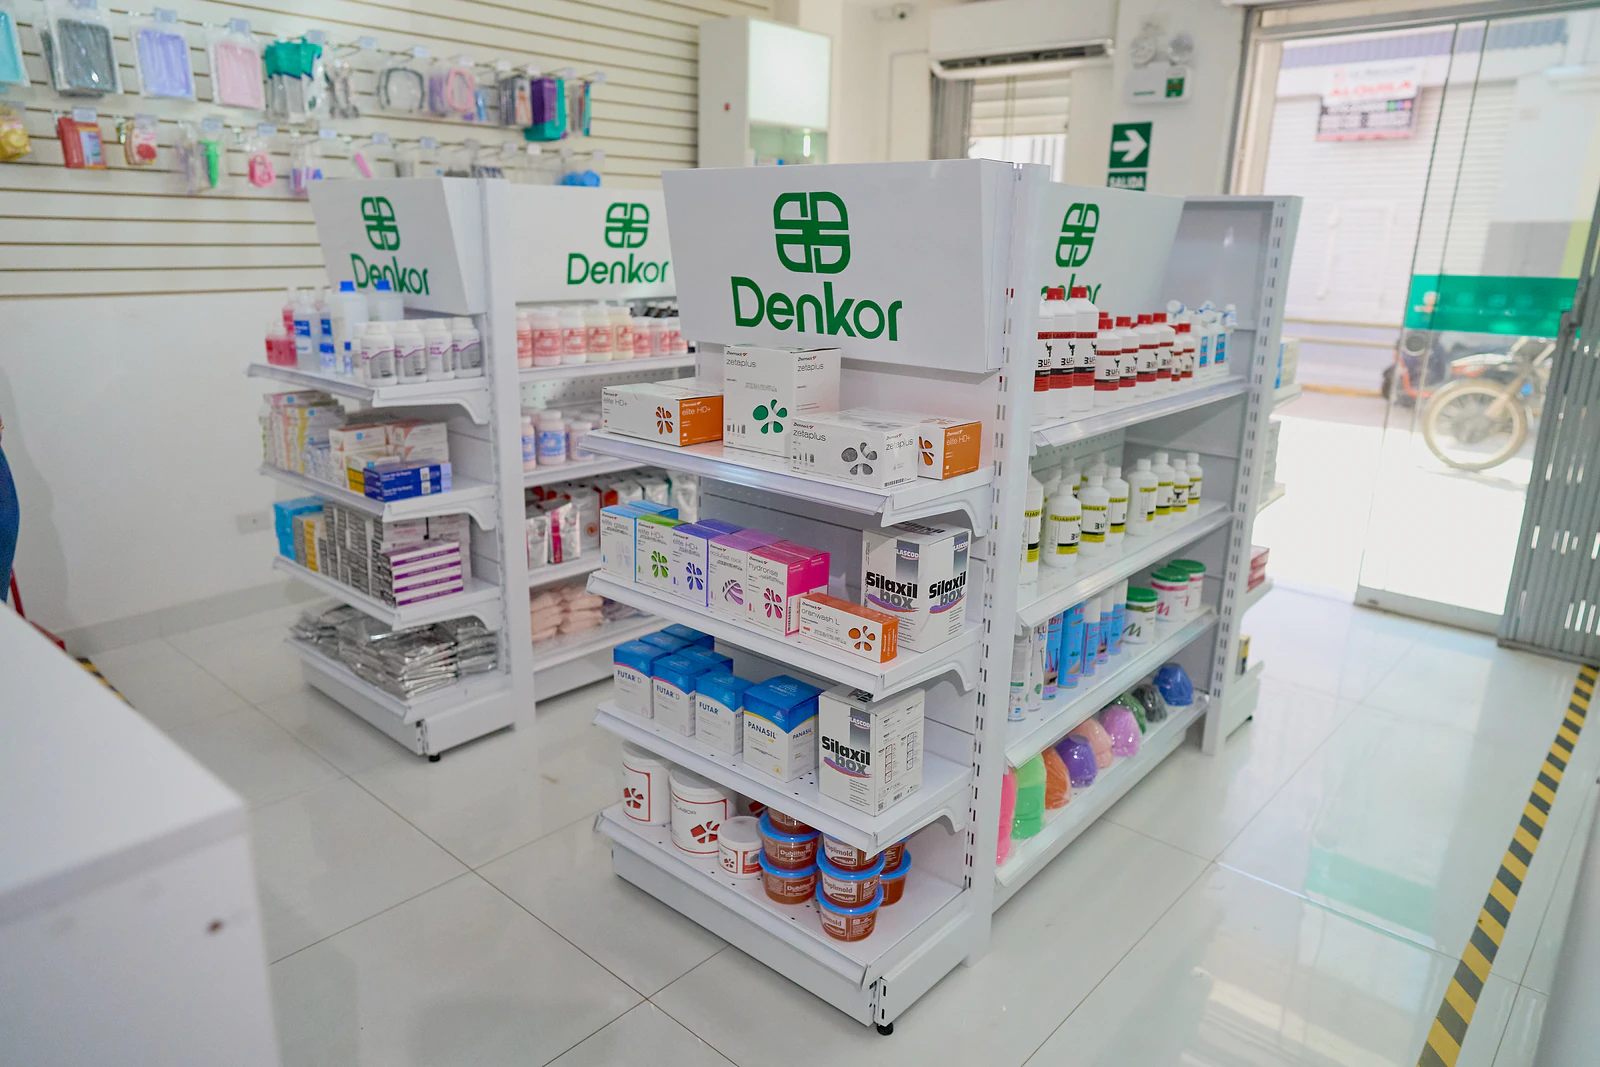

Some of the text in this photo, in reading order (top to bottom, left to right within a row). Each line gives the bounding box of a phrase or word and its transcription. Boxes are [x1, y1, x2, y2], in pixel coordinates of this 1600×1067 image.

[350, 253, 430, 296] Denkor
[566, 253, 670, 285] Denkor
[730, 276, 903, 342] Denkor
[726, 358, 757, 368] zetaplus
[797, 363, 824, 372] zetaplus
[682, 405, 711, 416] elite HD+
[793, 429, 827, 442] zetaplus
[895, 548, 920, 559] LASCOD
[953, 541, 969, 551] LASCOD
[748, 561, 779, 578] hydrorise
[866, 571, 918, 599] Silaxil
[929, 571, 967, 599] Silaxil
[880, 590, 914, 609] box
[940, 587, 964, 606] box
[801, 608, 834, 624] oranwash
[835, 618, 840, 626] L
[617, 669, 636, 682] FUTAR
[656, 685, 675, 698] FUTAR
[699, 701, 719, 715] FUTAR
[747, 721, 777, 740] PANASIL
[849, 716, 871, 729] LASCOD
[792, 727, 813, 740] PANASIL
[821, 735, 871, 766] Silaxil
[835, 752, 867, 776] box
